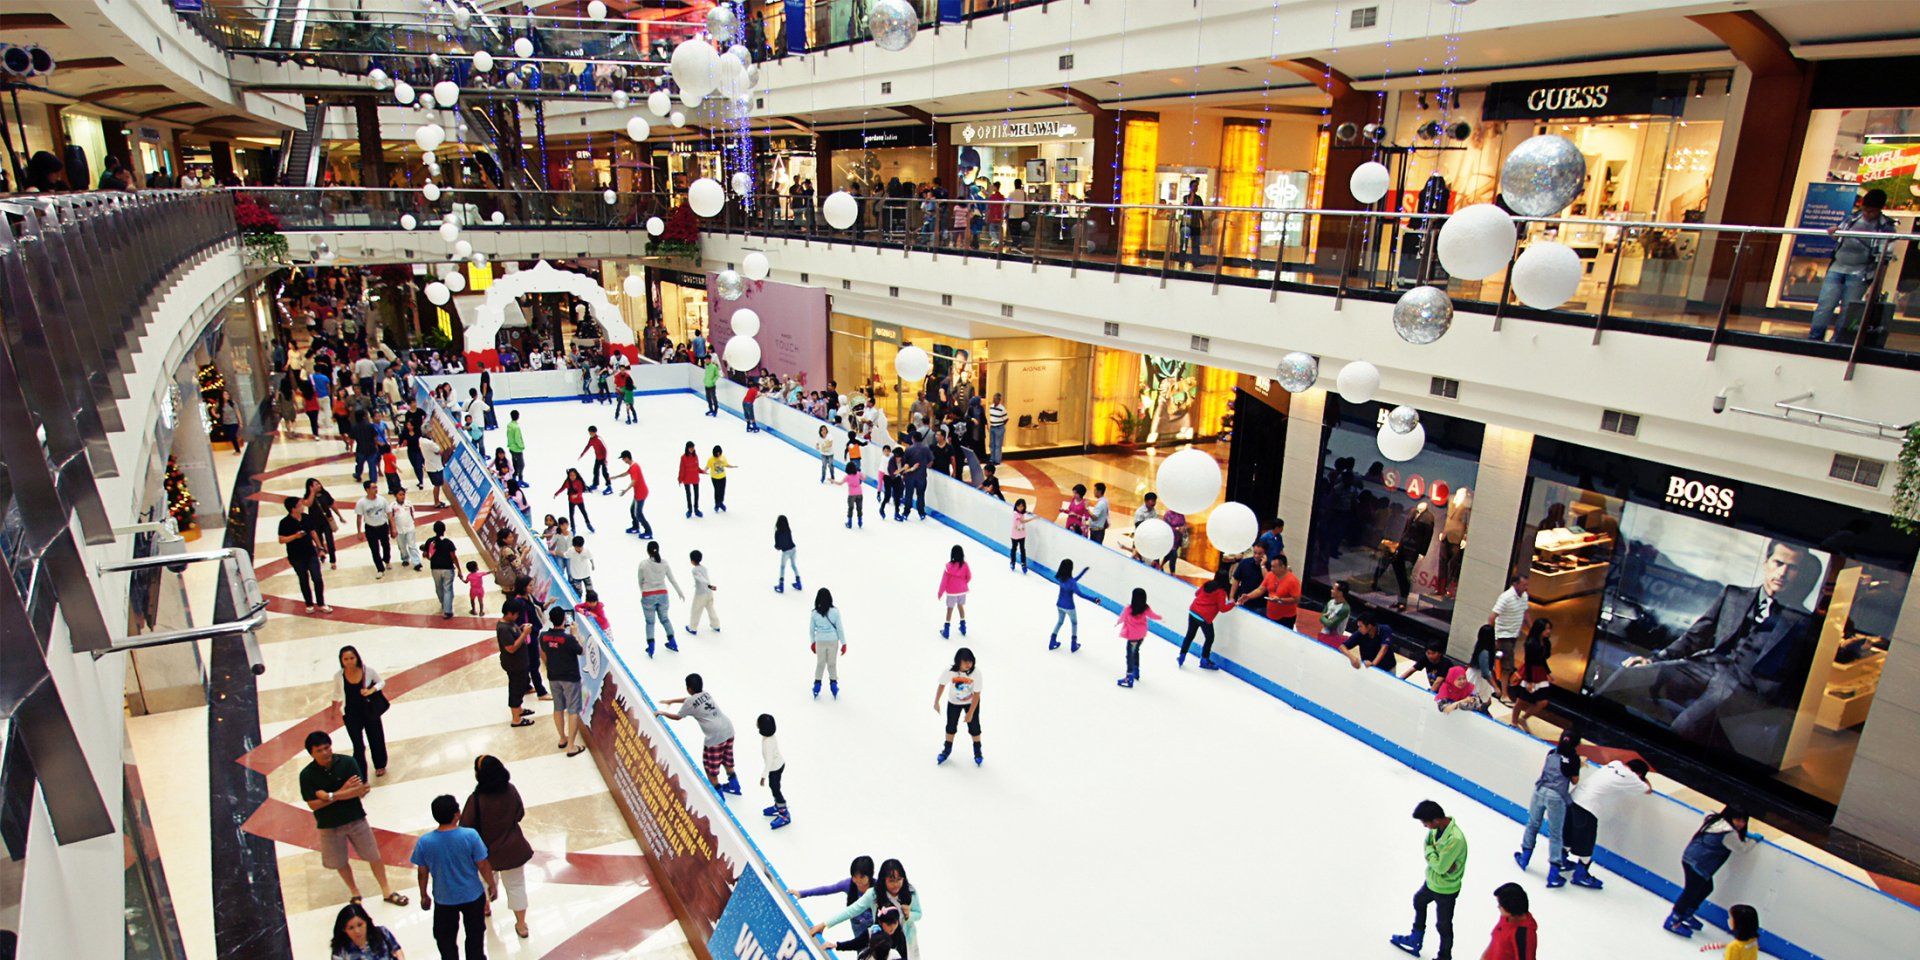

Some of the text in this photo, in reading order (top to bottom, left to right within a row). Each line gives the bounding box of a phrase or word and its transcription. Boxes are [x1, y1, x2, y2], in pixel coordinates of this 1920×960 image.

[1527, 84, 1609, 112] GUESS
[1010, 120, 1060, 137] MELAWAI
[1859, 149, 1901, 166] JOYFUL
[1861, 168, 1892, 184] SALE
[1384, 472, 1442, 501] SAL
[1665, 475, 1735, 510] BOSS
[639, 760, 670, 812] PLAYGROUND
[667, 807, 676, 822] IS
[673, 818, 697, 856] COMING
[640, 781, 659, 816] NORTH
[657, 811, 684, 857] SKYWALK
[643, 750, 655, 770] TIME
[652, 765, 665, 785] EVER
[662, 782, 671, 795] AT
[668, 792, 675, 803] A
[673, 798, 699, 839] SHOPPING
[696, 835, 712, 861] MALL
